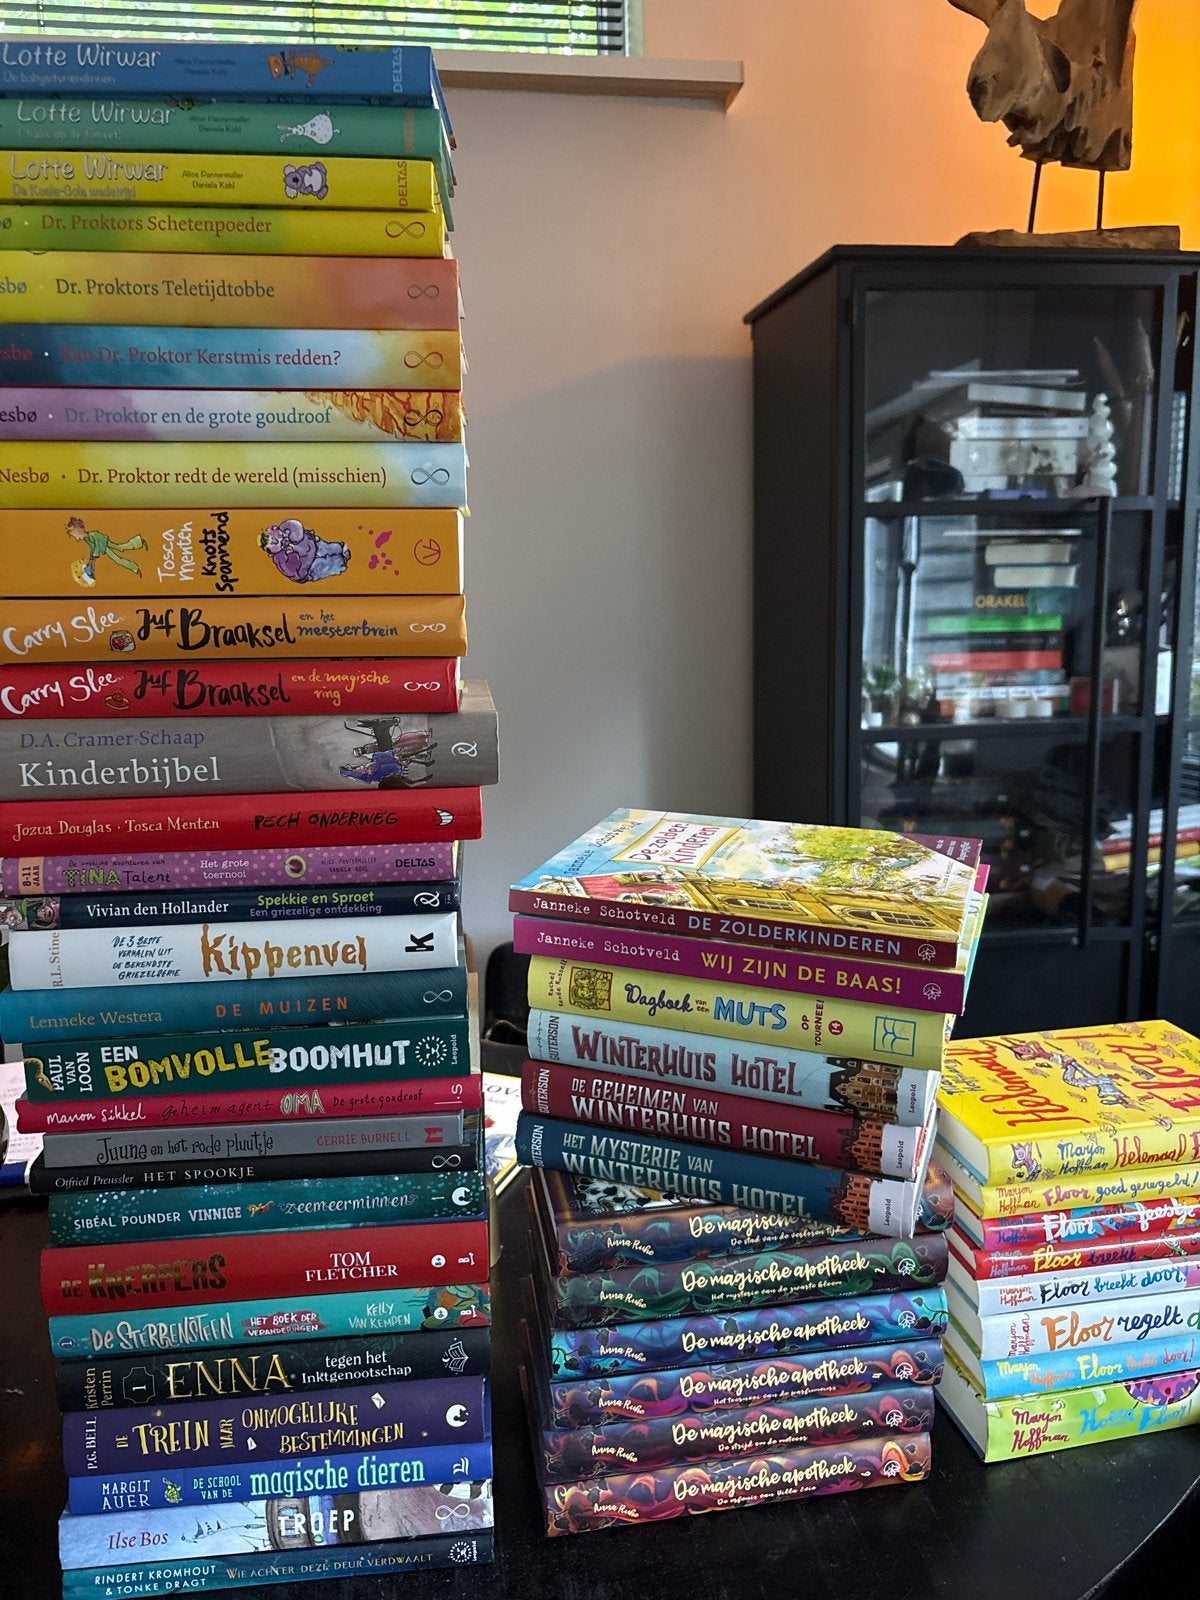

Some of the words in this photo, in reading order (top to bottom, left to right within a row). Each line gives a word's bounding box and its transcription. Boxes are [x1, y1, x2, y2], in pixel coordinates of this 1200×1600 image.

[2, 44, 67, 67] Lotte
[77, 46, 161, 68] Wirwar
[17, 100, 80, 123] Lotte
[92, 101, 175, 125] Wirwar
[9, 154, 74, 180] Lotte
[84, 154, 168, 182] Wirwar
[398, 160, 408, 207] DELTAS
[41, 214, 66, 230] Dr.
[71, 215, 143, 231] Proktors
[147, 216, 272, 238] Schetenpoeder
[56, 279, 82, 295] Dr.
[86, 280, 160, 296] Proktors
[164, 281, 275, 302] Teletijdtobbe
[60, 346, 94, 361] Kan
[98, 346, 124, 362] Dr.
[129, 347, 192, 363] Proktor
[197, 349, 270, 365] Kerstmis
[275, 349, 341, 367] redden?
[0, 467, 50, 485] Nesbø
[77, 468, 103, 484] Dr.
[108, 468, 170, 484] Proktor
[174, 468, 206, 485] redt
[210, 467, 231, 485] de
[235, 468, 289, 484] wereld
[292, 466, 387, 488] (misschien)
[975, 594, 1025, 609] ORAKEL
[135, 608, 174, 641] Juf
[177, 607, 296, 652] Braaksel
[133, 670, 172, 700] Juf
[173, 669, 291, 710] Braaksel
[20, 732, 60, 748] D.A.
[63, 729, 205, 750] Cramer-Schaap
[18, 757, 221, 791] Kinderbijbel
[13, 823, 53, 843] Jozua
[58, 819, 112, 836] Douglas
[125, 818, 163, 833] Tosca
[167, 816, 220, 831] Menten
[201, 859, 219, 869] Het
[221, 860, 249, 870] grote
[395, 857, 436, 868] DELTAS
[203, 870, 247, 880] toernooi
[86, 904, 130, 917] Vivian
[134, 903, 158, 916] den
[162, 900, 229, 915] Hollander
[250, 908, 268, 918] Een
[271, 905, 322, 918] griezelige
[324, 903, 382, 917] ontdekking
[533, 897, 590, 915] Janneke
[600, 905, 676, 926] Schotveld
[688, 916, 712, 931] DE
[720, 920, 901, 956] ZOLDERKINDEREN
[112, 936, 124, 947] DE
[127, 935, 135, 947] 3
[137, 936, 163, 947] BESTE
[200, 923, 367, 979] Kippenvel
[118, 949, 155, 958] VERHALEN
[158, 948, 173, 956] UIT
[537, 931, 594, 949] Janneke
[604, 940, 680, 961] Schotveld
[701, 952, 732, 974] WIJ
[743, 956, 787, 978] ZIJN
[798, 966, 826, 984] DE
[836, 970, 902, 994] BAAS!
[112, 961, 123, 970] DE
[124, 960, 174, 969] BEKENDSTE
[118, 969, 180, 980] GRIEZELSERIE
[216, 1003, 242, 1018] DE
[260, 996, 348, 1015] MUIZEN
[713, 996, 788, 1030] MUTS
[30, 1013, 95, 1029] Lenneke
[100, 1009, 162, 1026] Westera
[802, 1014, 810, 1031] OP
[814, 1000, 825, 1047] TOURNEE!
[548, 1016, 560, 1061] GUTERSON
[100, 1046, 139, 1063] EEN
[104, 1039, 272, 1092] BOMVOLLE
[268, 1040, 411, 1073] BOOMHUT
[571, 1025, 717, 1083] WINTERHUIS
[731, 1053, 802, 1097] HOTEL
[65, 1061, 77, 1085] VAN
[76, 1051, 93, 1093] LOON
[538, 1069, 550, 1114] GUTERSON
[570, 1095, 731, 1144] WINTERHUIS
[741, 1124, 821, 1161] HOTEL
[563, 1133, 583, 1150] HET
[590, 1135, 680, 1171] MYSTERIE
[688, 1155, 713, 1174] VAN
[1111, 1134, 1187, 1169] Helemaal
[55, 1175, 89, 1188] Otfried
[93, 1174, 134, 1186] Preussler
[144, 1171, 176, 1182] HET
[184, 1166, 254, 1180] SPOOKJE
[562, 1151, 722, 1203] WINTERHUIS
[731, 1183, 811, 1220] HOTEL
[996, 1186, 1032, 1198] Marjon
[74, 1215, 116, 1230] SIBÉAL
[121, 1211, 181, 1226] POUNDER
[188, 1206, 242, 1222] VINNIGE
[884, 1198, 892, 1226] Leopold
[330, 1252, 371, 1267] TOM
[305, 1265, 398, 1282] FLETCHER
[681, 1270, 708, 1292] De
[710, 1262, 792, 1290] magische
[793, 1252, 870, 1277] apotheek
[251, 1317, 267, 1327] HET
[273, 1314, 297, 1325] BOEK
[301, 1313, 317, 1323] DER
[1040, 1311, 1116, 1350] Floor
[1117, 1305, 1183, 1340] regelt
[682, 1332, 708, 1354] De
[709, 1323, 792, 1351] magische
[793, 1312, 870, 1339] apotheek
[325, 1353, 362, 1369] tegen
[366, 1351, 387, 1364] het
[165, 1354, 292, 1399] ENNA
[301, 1365, 412, 1384] Inktgenootschap
[681, 1376, 706, 1397] De
[708, 1367, 790, 1395] magische
[791, 1356, 867, 1386] apotheek
[86, 1416, 97, 1450] BELL
[672, 1423, 698, 1445] De
[700, 1414, 781, 1443] magische
[783, 1404, 858, 1432] apotheek
[116, 1435, 128, 1448] DE
[132, 1420, 209, 1455] TREIN
[87, 1451, 98, 1469] P.G.
[102, 1480, 150, 1494] MARGIT
[193, 1478, 203, 1489] DE
[207, 1475, 241, 1488] SCHOOL
[251, 1460, 348, 1497] magische
[358, 1456, 425, 1486] dieren
[673, 1479, 699, 1500] De
[701, 1469, 782, 1498] magische
[782, 1456, 857, 1483] apotheek
[102, 1494, 150, 1510] AUER
[201, 1490, 219, 1499] VAN
[222, 1488, 232, 1498] DE
[594, 1503, 616, 1514] Anna
[616, 1504, 639, 1518] Ruhe
[95, 1571, 143, 1585] RINDERT
[149, 1565, 216, 1580] KROMHOUT
[226, 1567, 246, 1579] WIE
[250, 1565, 294, 1578] ACHTER
[301, 1563, 329, 1573] DEZE
[334, 1560, 362, 1569] DEUR
[367, 1553, 433, 1566] VERDWAALT
[105, 1587, 112, 1595] &
[116, 1582, 159, 1594] TONKE
[165, 1578, 206, 1590] DRAGT
